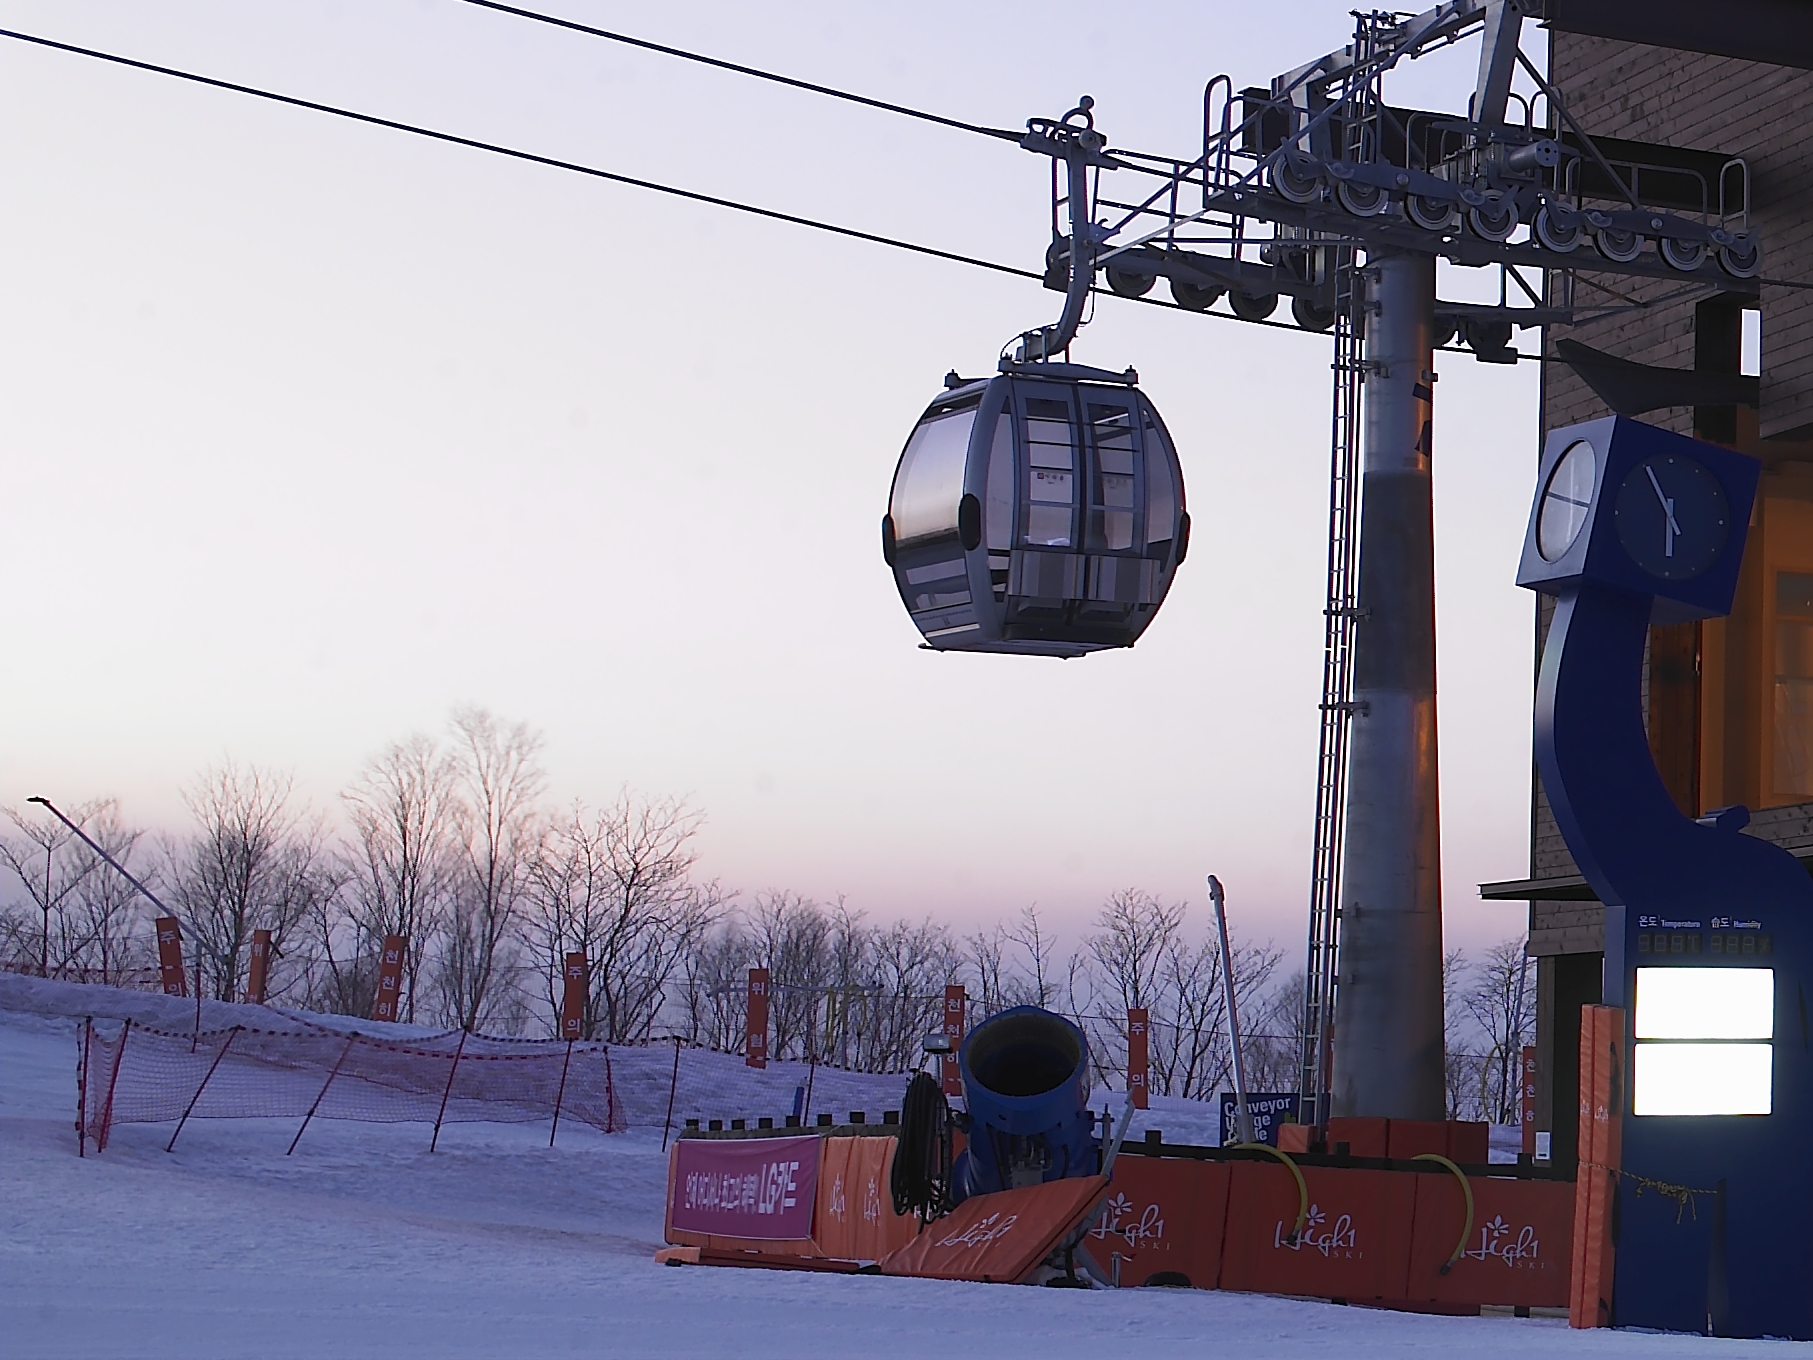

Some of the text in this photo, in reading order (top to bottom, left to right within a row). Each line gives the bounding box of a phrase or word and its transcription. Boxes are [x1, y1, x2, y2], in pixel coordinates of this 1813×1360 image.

[1638, 915, 1658, 928] 온도
[1711, 916, 1730, 929] 습도
[378, 950, 399, 1017] 천천히
[567, 965, 583, 1033] 주의
[1131, 1022, 1144, 1087] 주의
[759, 1161, 799, 1215] LG카드
